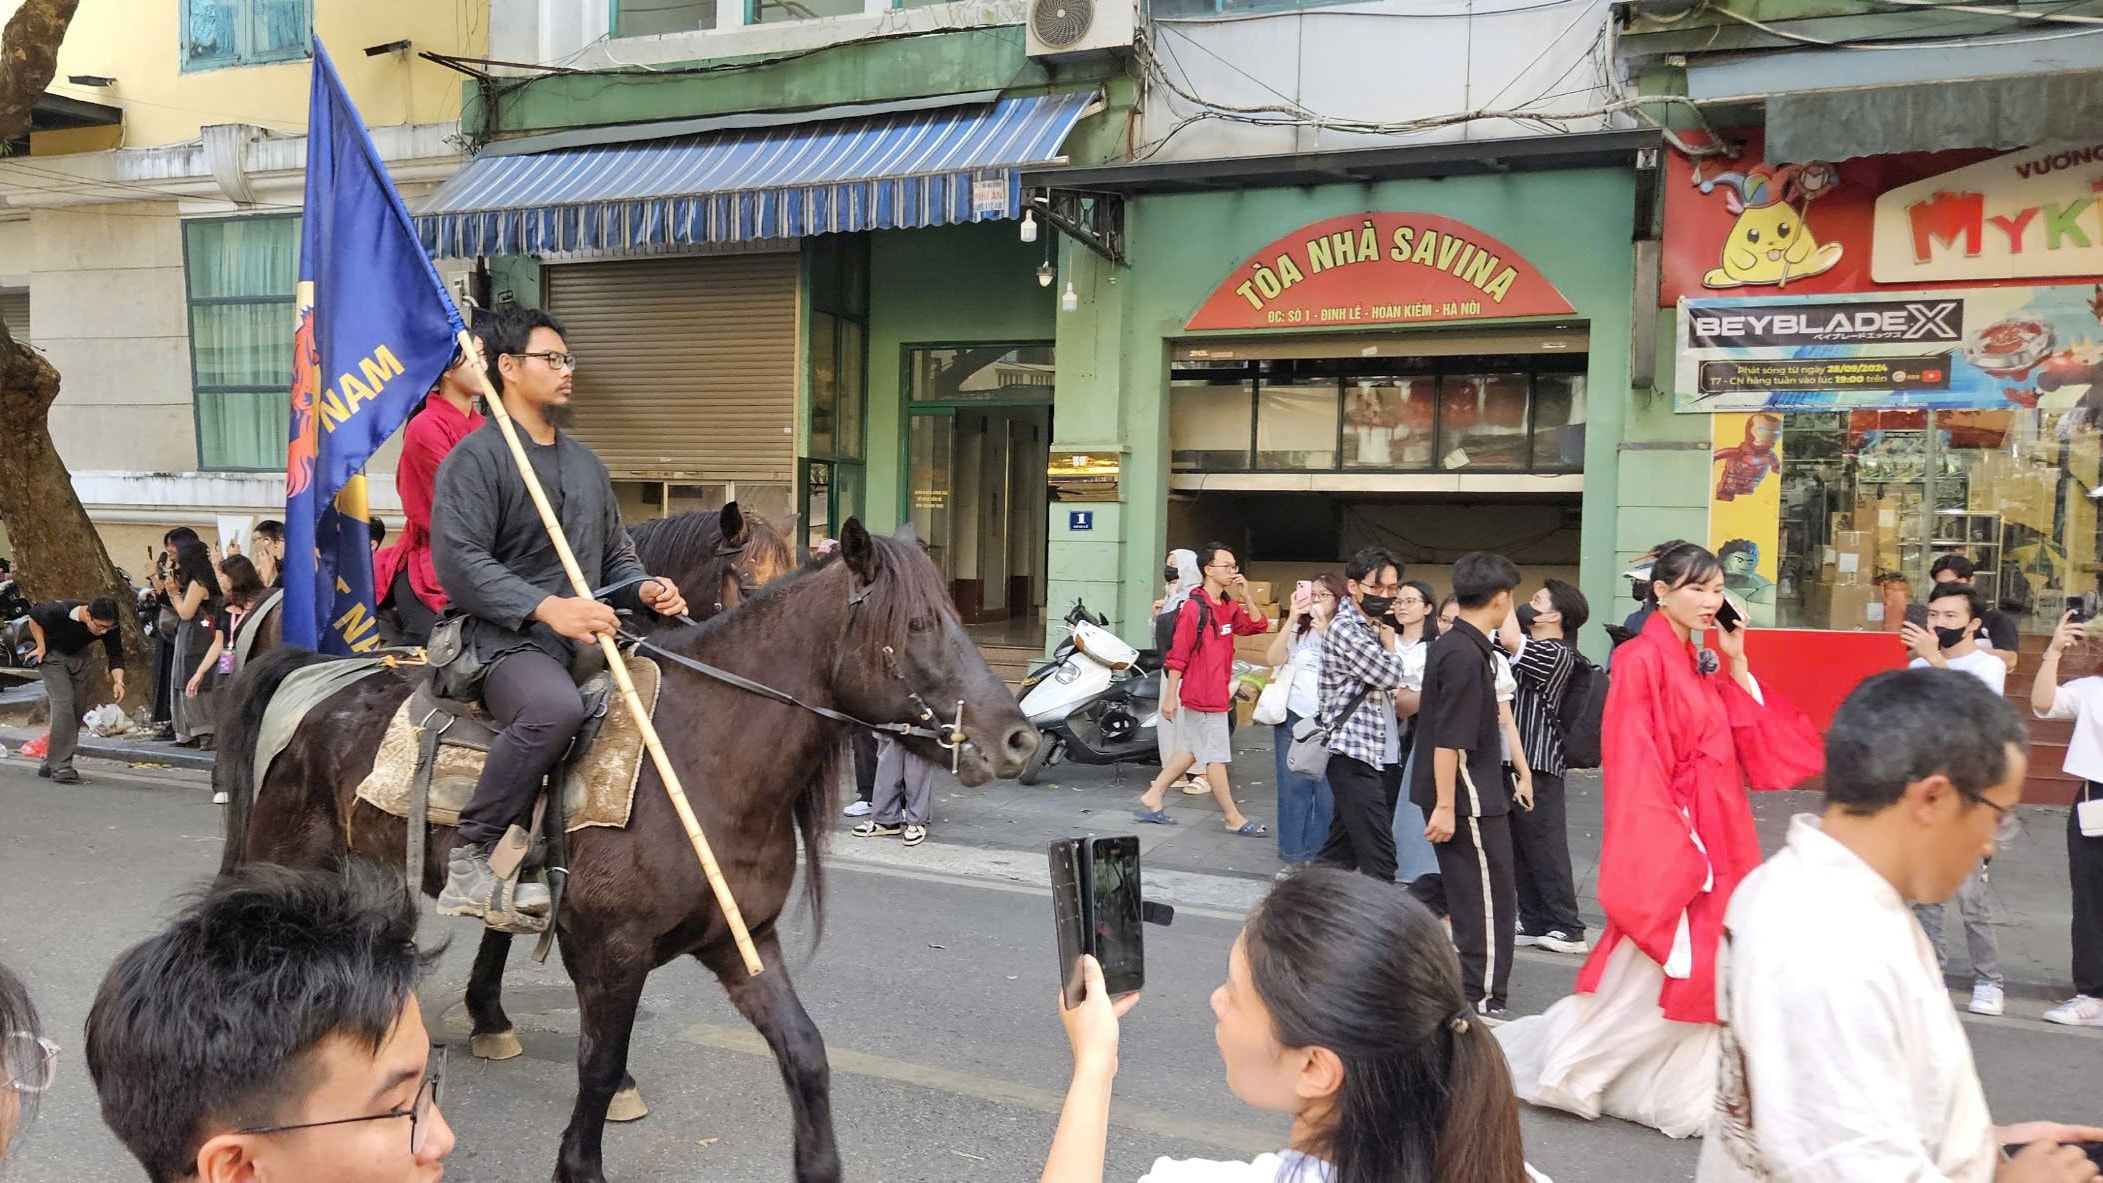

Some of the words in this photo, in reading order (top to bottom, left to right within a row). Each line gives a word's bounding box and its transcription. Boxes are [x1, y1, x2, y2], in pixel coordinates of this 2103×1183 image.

[1906, 177, 2103, 265] MYK
[1235, 253, 1305, 311] TÒA
[1305, 220, 1380, 273] NHÀ
[1390, 225, 1519, 303] SAVINA
[1288, 305, 1302, 321] SỐ
[1372, 303, 1401, 319] HOÀN
[1443, 301, 1458, 316] HÀ
[1461, 300, 1480, 316] NỘI
[1729, 377, 1744, 385] CN
[1747, 376, 1772, 386] hàng
[1799, 375, 1816, 384] vào
[1818, 375, 1833, 384] lúc
[1835, 375, 1865, 384] 19:00
[1866, 374, 1888, 383] trên
[1737, 365, 1760, 374] Phát
[1762, 366, 1786, 376] sóng
[1801, 366, 1825, 376] ngày
[319, 344, 405, 433] NAM
[1076, 513, 1087, 524] 1
